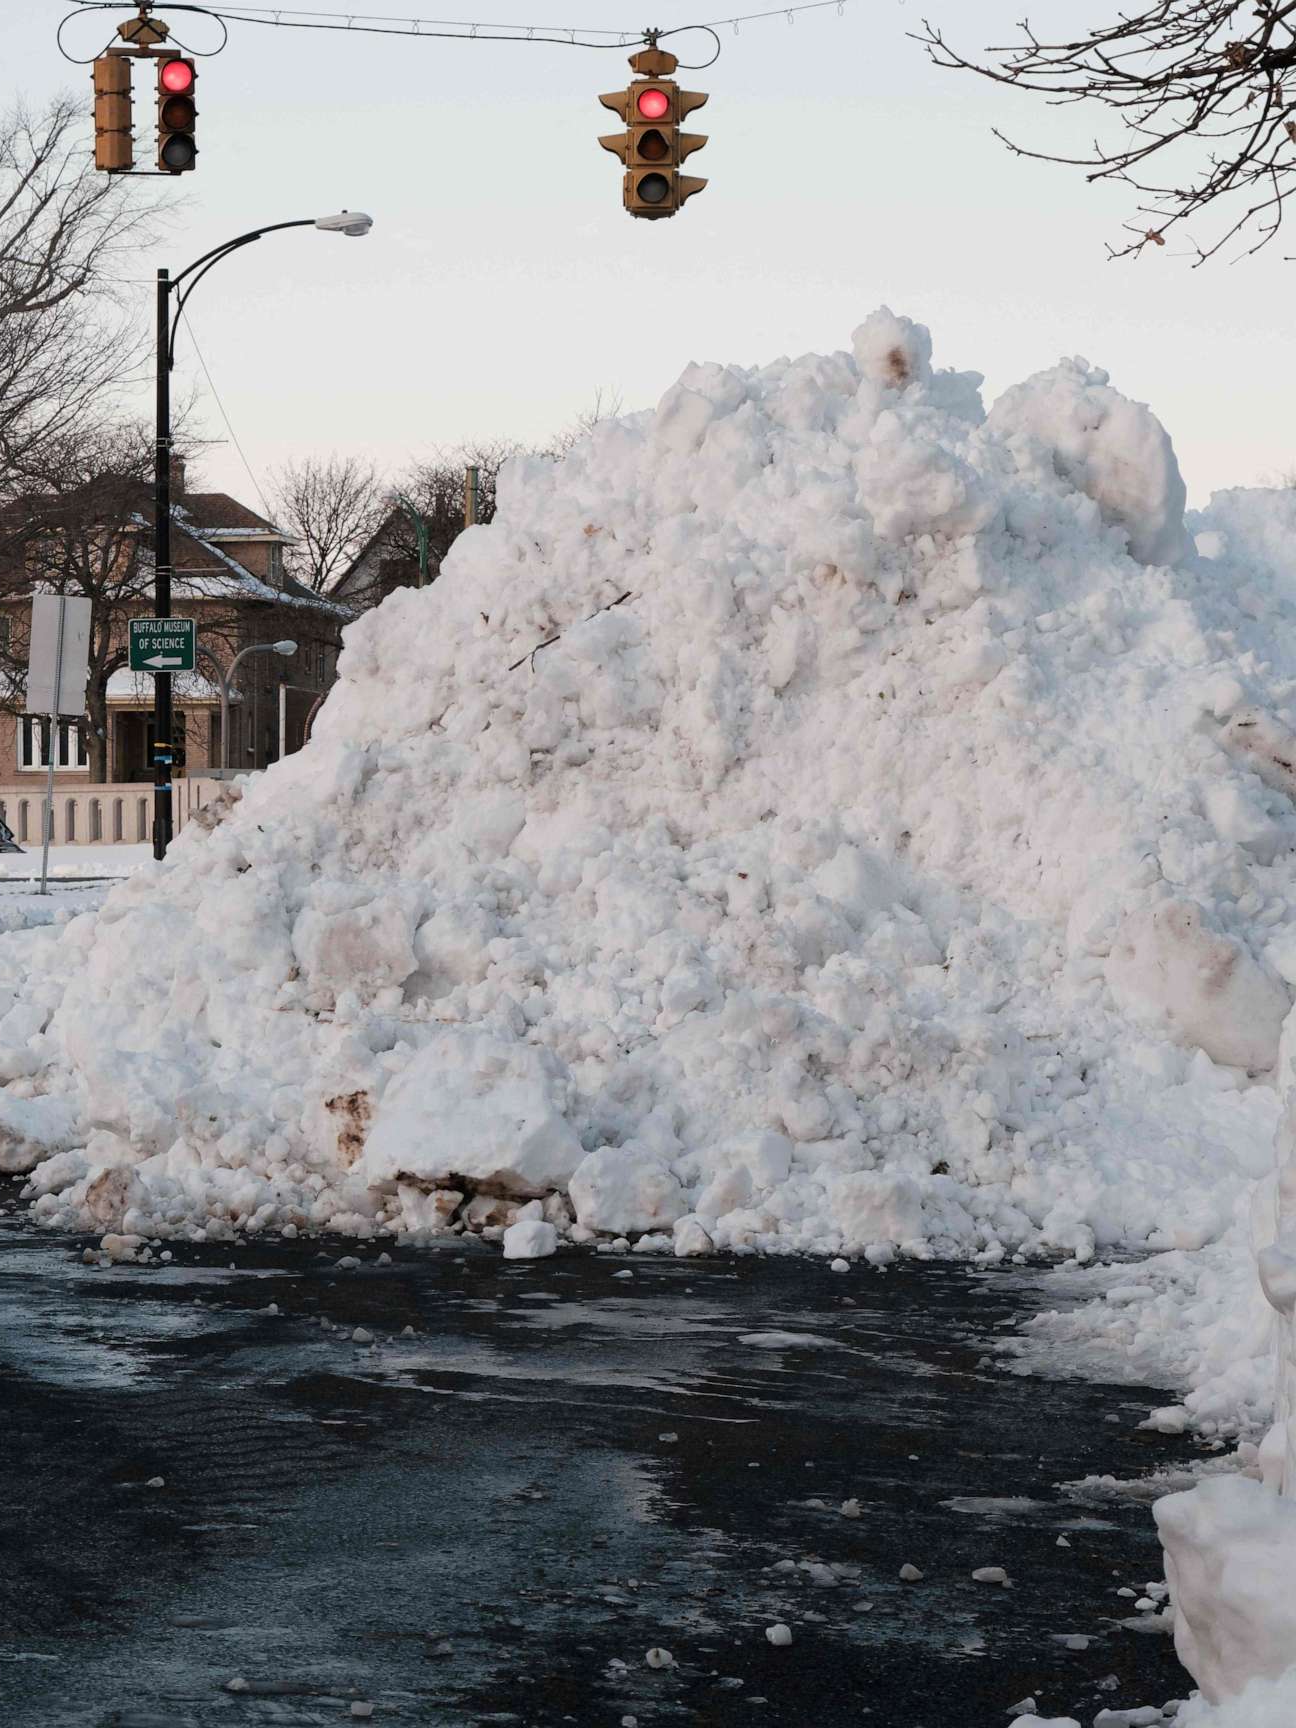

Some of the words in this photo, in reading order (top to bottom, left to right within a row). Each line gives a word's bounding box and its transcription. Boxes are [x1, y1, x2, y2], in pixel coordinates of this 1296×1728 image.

[133, 622, 162, 633] BUFFALO
[164, 621, 190, 632] MUSEUM
[139, 638, 149, 649] OF
[152, 638, 185, 649] SCIENCE
